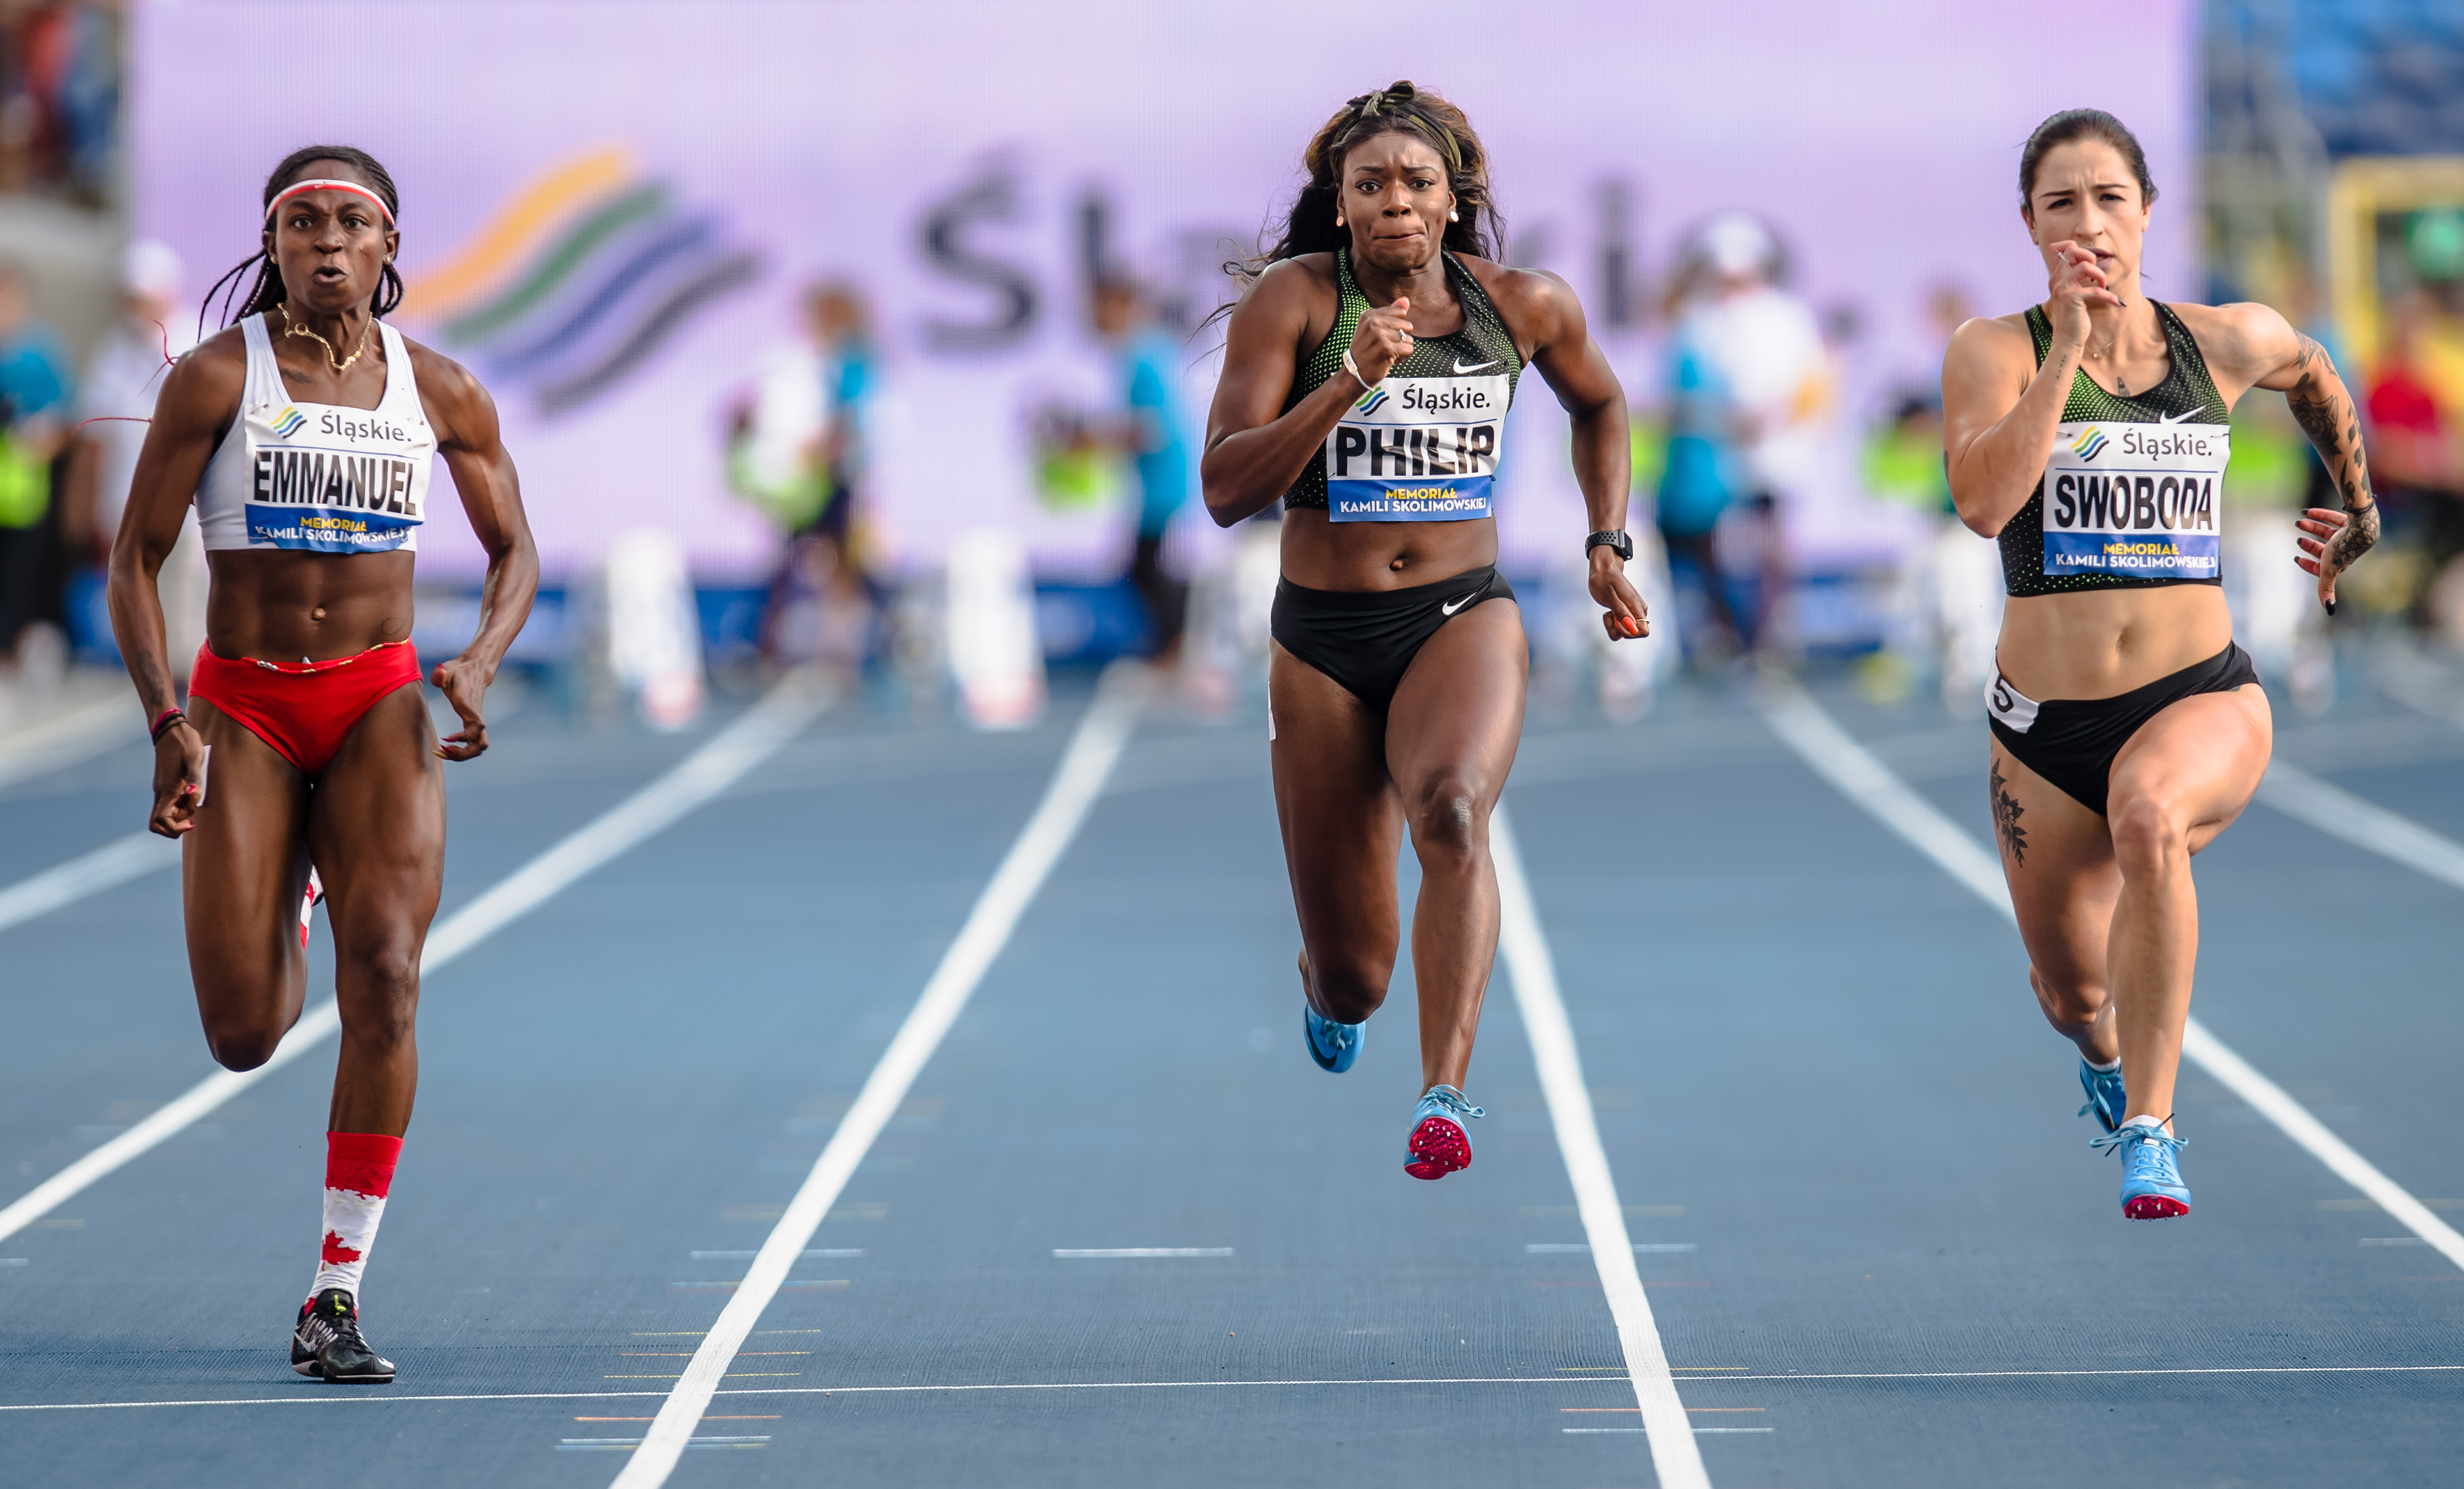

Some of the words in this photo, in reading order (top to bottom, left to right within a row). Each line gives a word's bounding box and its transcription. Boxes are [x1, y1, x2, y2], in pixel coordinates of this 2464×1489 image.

[1402, 383, 1491, 415] Śląskie.
[320, 410, 412, 442] Śląskie.
[1335, 425, 1495, 477] PHILIP
[2123, 428, 2212, 461] Śląskie.
[253, 450, 417, 516] EMMANUEL
[1385, 488, 1458, 500] MEMORIAŁ
[1340, 501, 1388, 513] KAMILI
[1392, 497, 1487, 512] SKOLIMOWSKIEJ
[2054, 474, 2213, 530] SWOBODA
[255, 526, 303, 539] KAMILI
[305, 527, 405, 545] SKOLIMOWSKIEJ
[300, 516, 367, 532] MEMORIAŁ
[2055, 553, 2106, 567] KAMILI
[2109, 555, 2216, 568] SKOLIMOWSKIEJ
[2103, 543, 2180, 555] MEMORIAŁ
